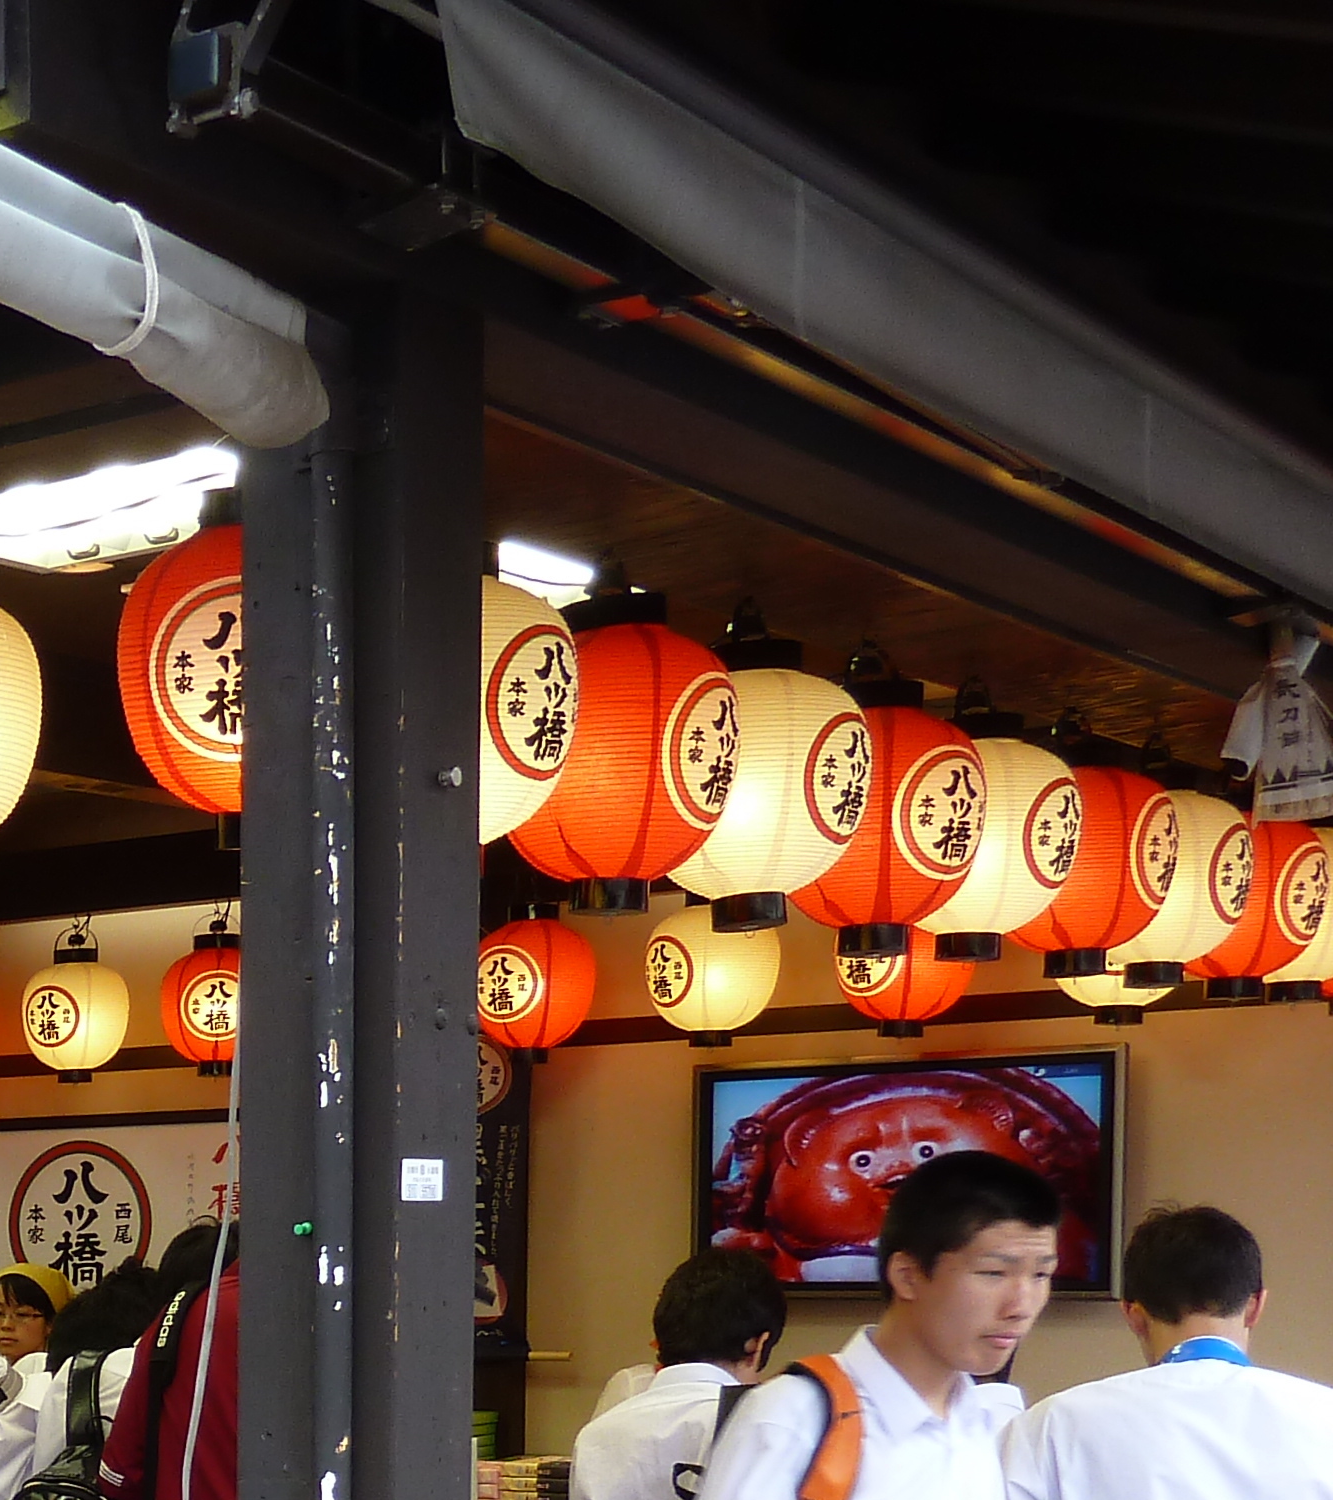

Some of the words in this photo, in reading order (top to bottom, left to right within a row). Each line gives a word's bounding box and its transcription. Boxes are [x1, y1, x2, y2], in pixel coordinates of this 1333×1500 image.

[172, 651, 195, 694] 本家
[507, 677, 527, 717] 本家
[688, 727, 706, 764] 本家
[821, 755, 838, 788] 本家
[918, 795, 936, 827] 本家
[1037, 819, 1052, 847] 本家
[26, 1204, 46, 1243] 本家
[113, 1203, 133, 1244] 西尾
[156, 1290, 186, 1348] adidas
